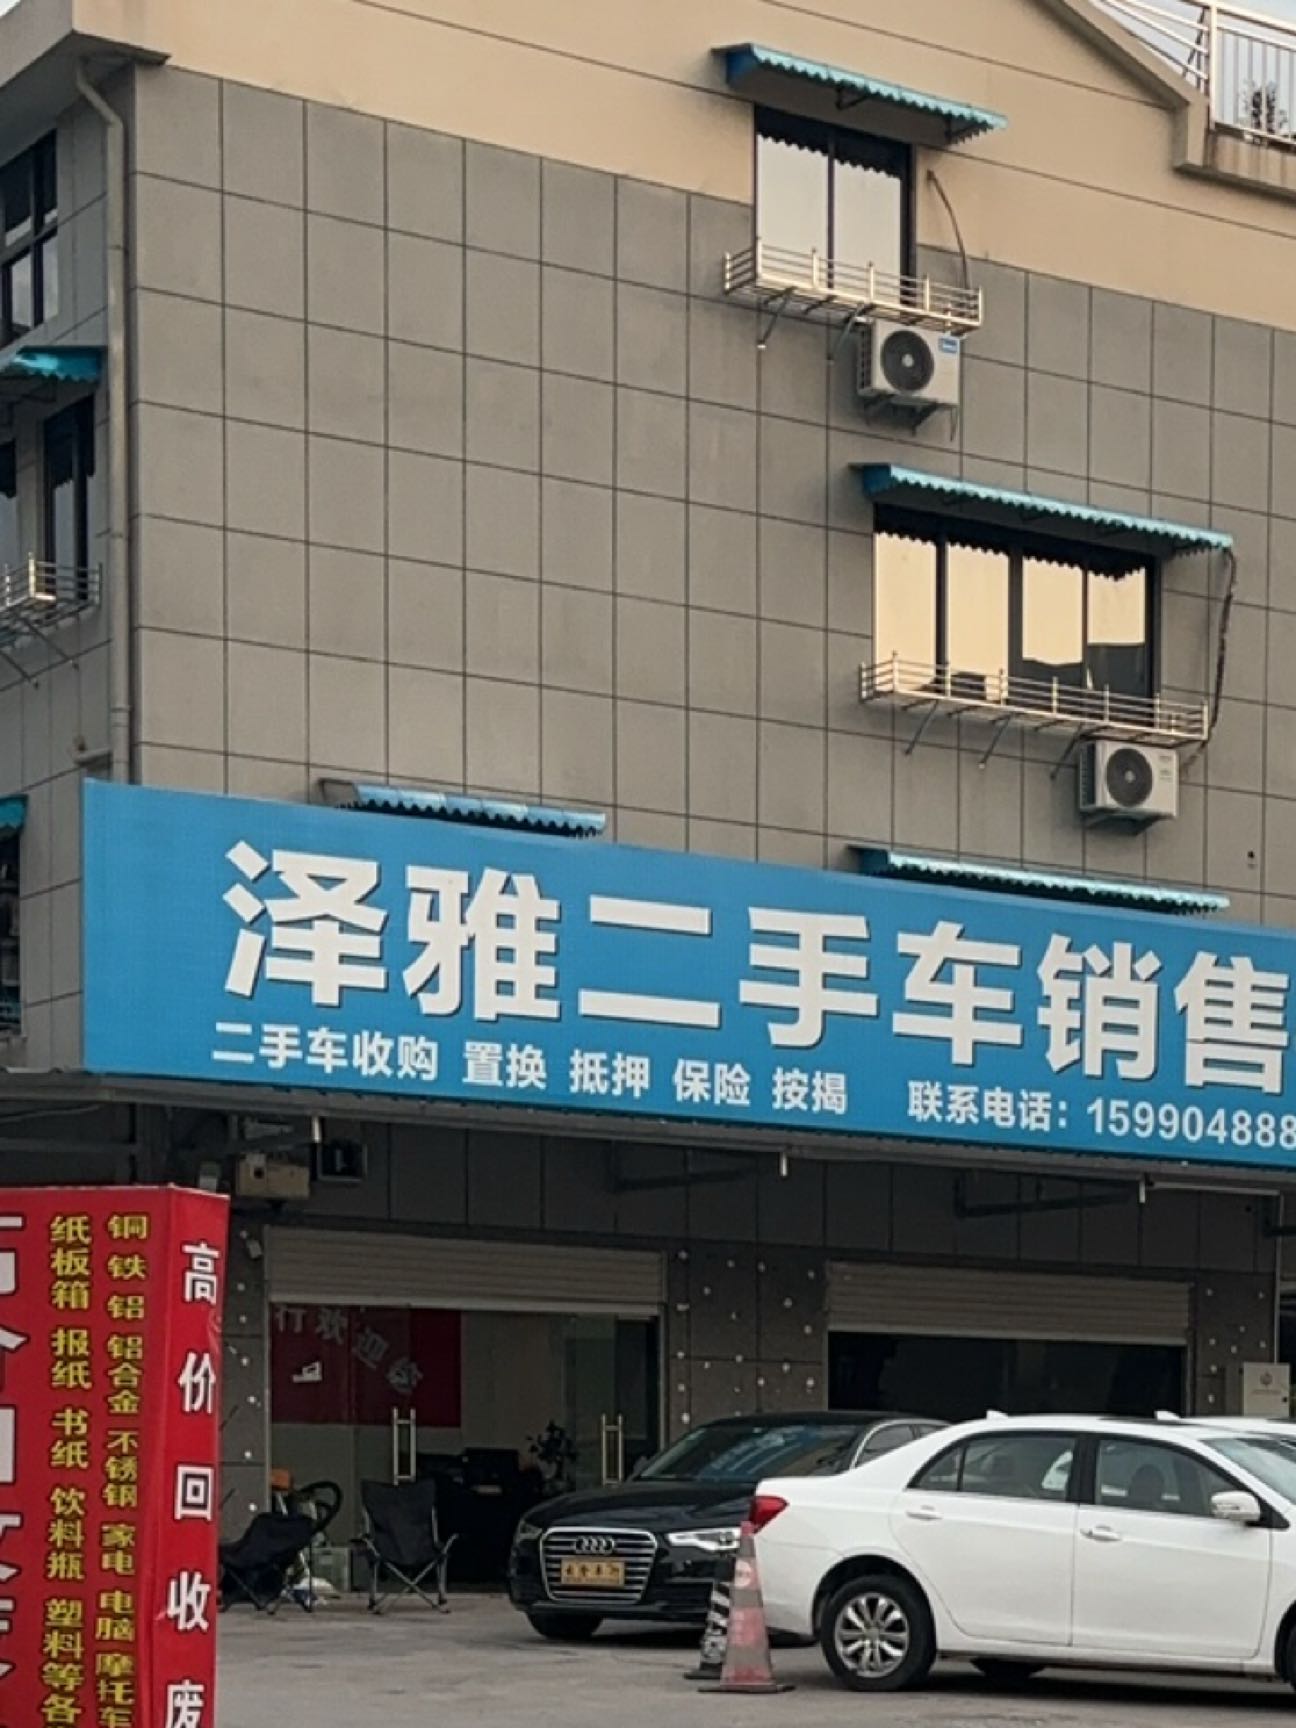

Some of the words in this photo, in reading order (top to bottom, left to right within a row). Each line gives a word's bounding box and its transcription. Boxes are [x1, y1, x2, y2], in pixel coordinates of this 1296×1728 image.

[223, 839, 1291, 1097] 泽雅二手车销售
[212, 1021, 439, 1083] 二手车收购
[461, 1040, 547, 1091] 置换
[569, 1048, 651, 1099] 抵押
[672, 1058, 751, 1107] 保险
[772, 1067, 848, 1116] 按揭
[50, 1215, 92, 1310] 纸板箱
[51, 1328, 92, 1389] 报纸
[106, 1335, 144, 1414] 铝合金
[50, 1408, 89, 1468] 书纸
[102, 1430, 138, 1508] 不锈钢
[47, 1487, 85, 1580] 饮料瓶
[101, 1523, 136, 1576] 家电
[95, 1590, 135, 1642] 电脑
